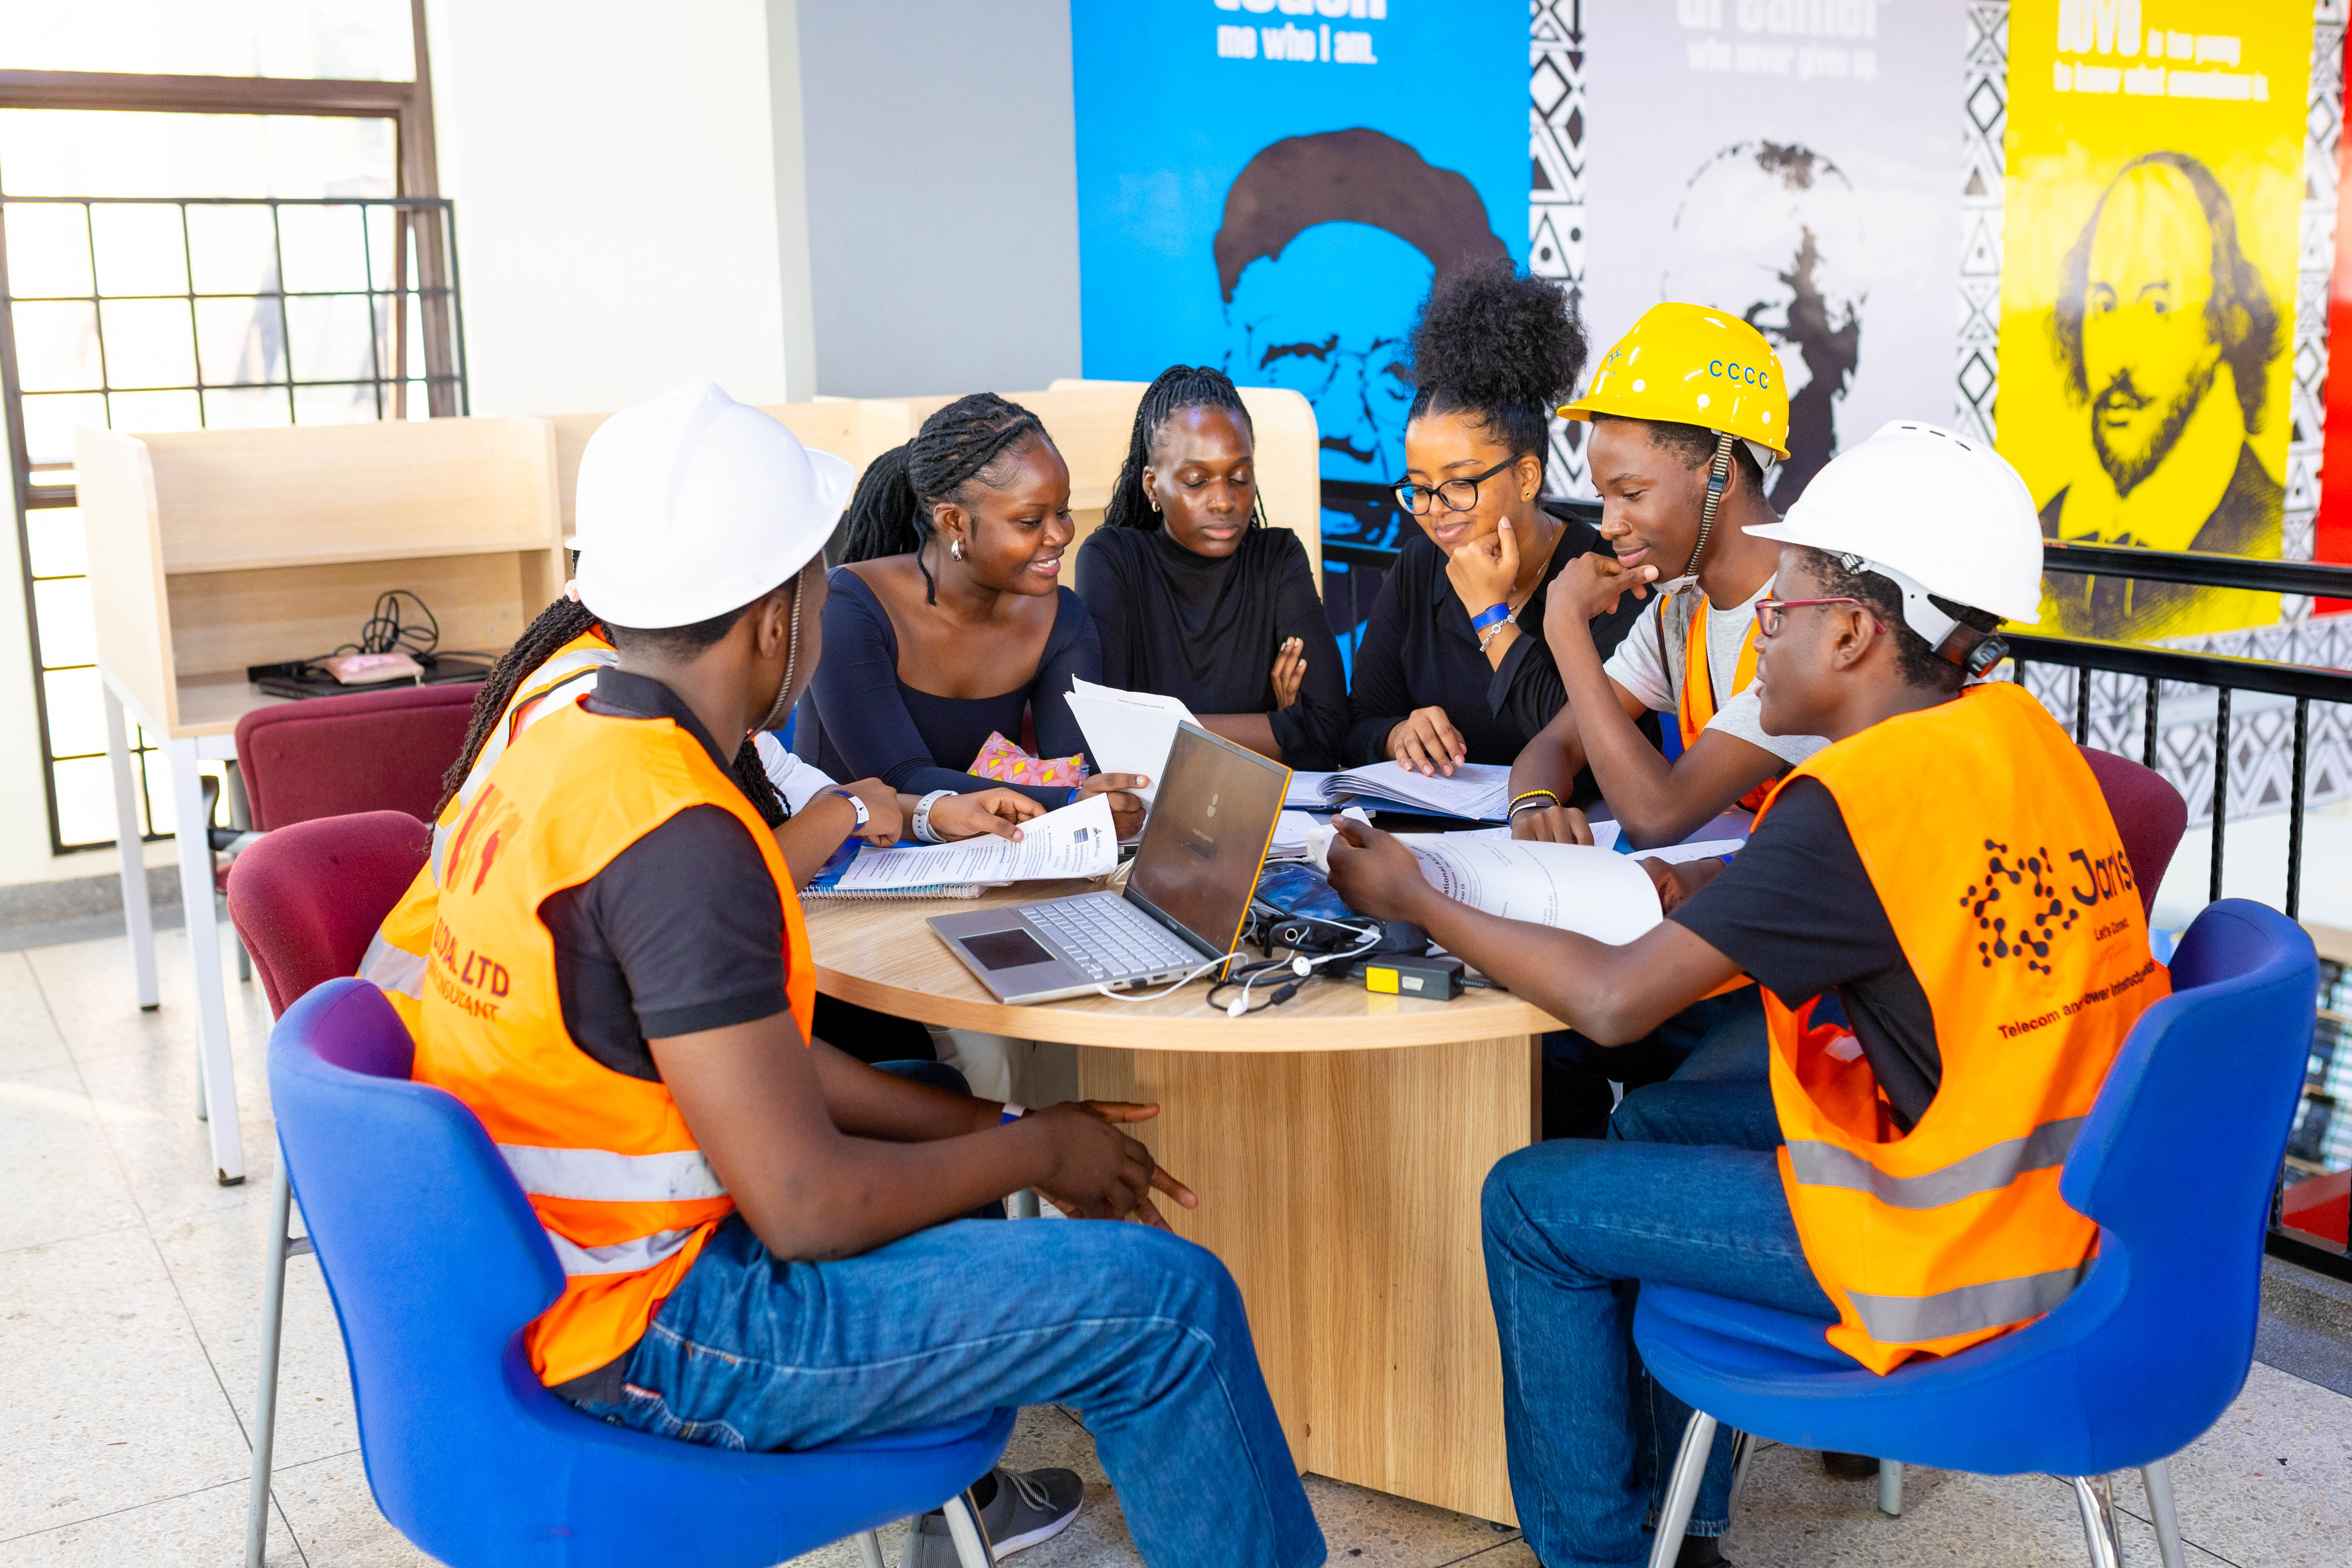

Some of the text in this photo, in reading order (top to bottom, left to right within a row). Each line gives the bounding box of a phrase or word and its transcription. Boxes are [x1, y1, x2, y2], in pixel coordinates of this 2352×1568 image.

[1218, 22, 1378, 64] me who I am.
[1710, 360, 1768, 389] CCCC
[1438, 866, 1449, 895] ational
[460, 949, 509, 998] LTD
[1998, 1010, 2060, 1039] Telecom
